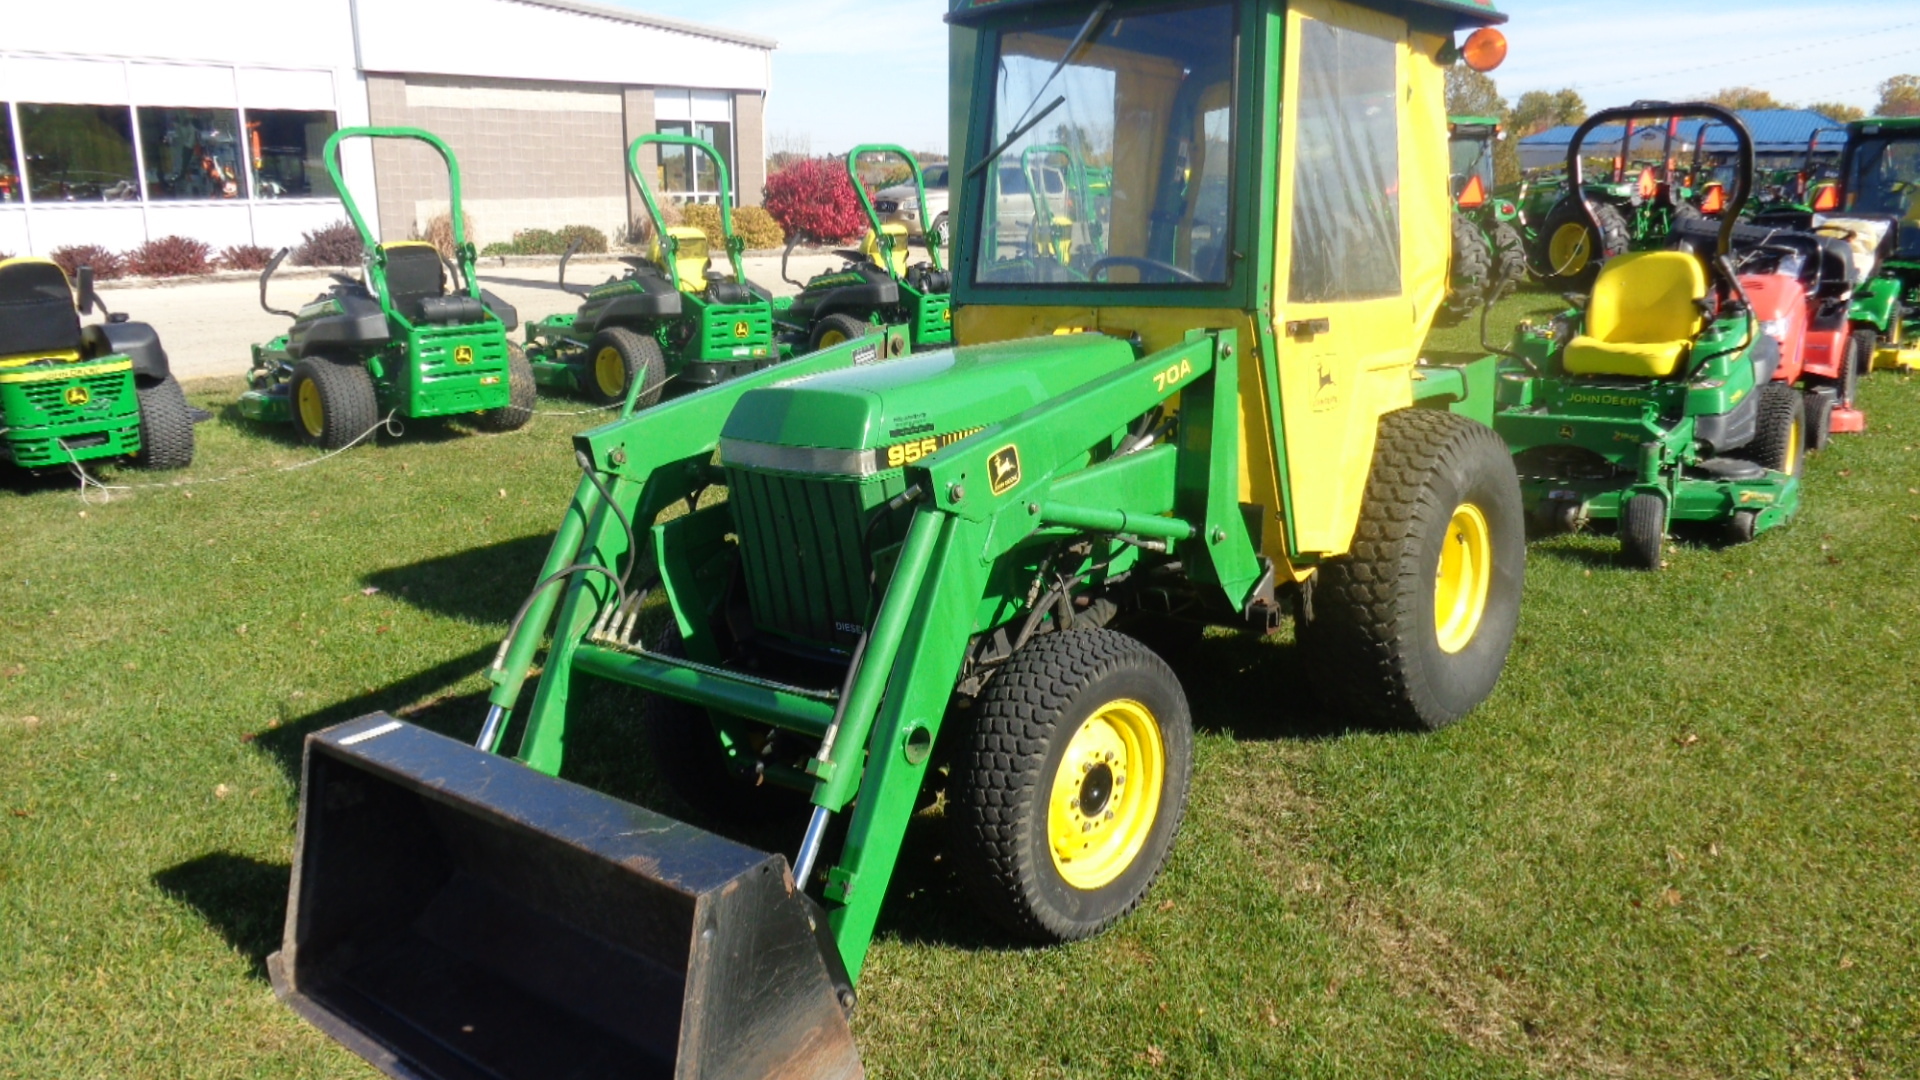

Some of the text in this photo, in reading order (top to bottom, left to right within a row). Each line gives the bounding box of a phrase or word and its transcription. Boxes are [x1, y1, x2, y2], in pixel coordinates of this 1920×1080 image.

[1152, 359, 1191, 392] 70A
[1567, 392, 1601, 404] JOHN
[887, 438, 938, 467] 955
